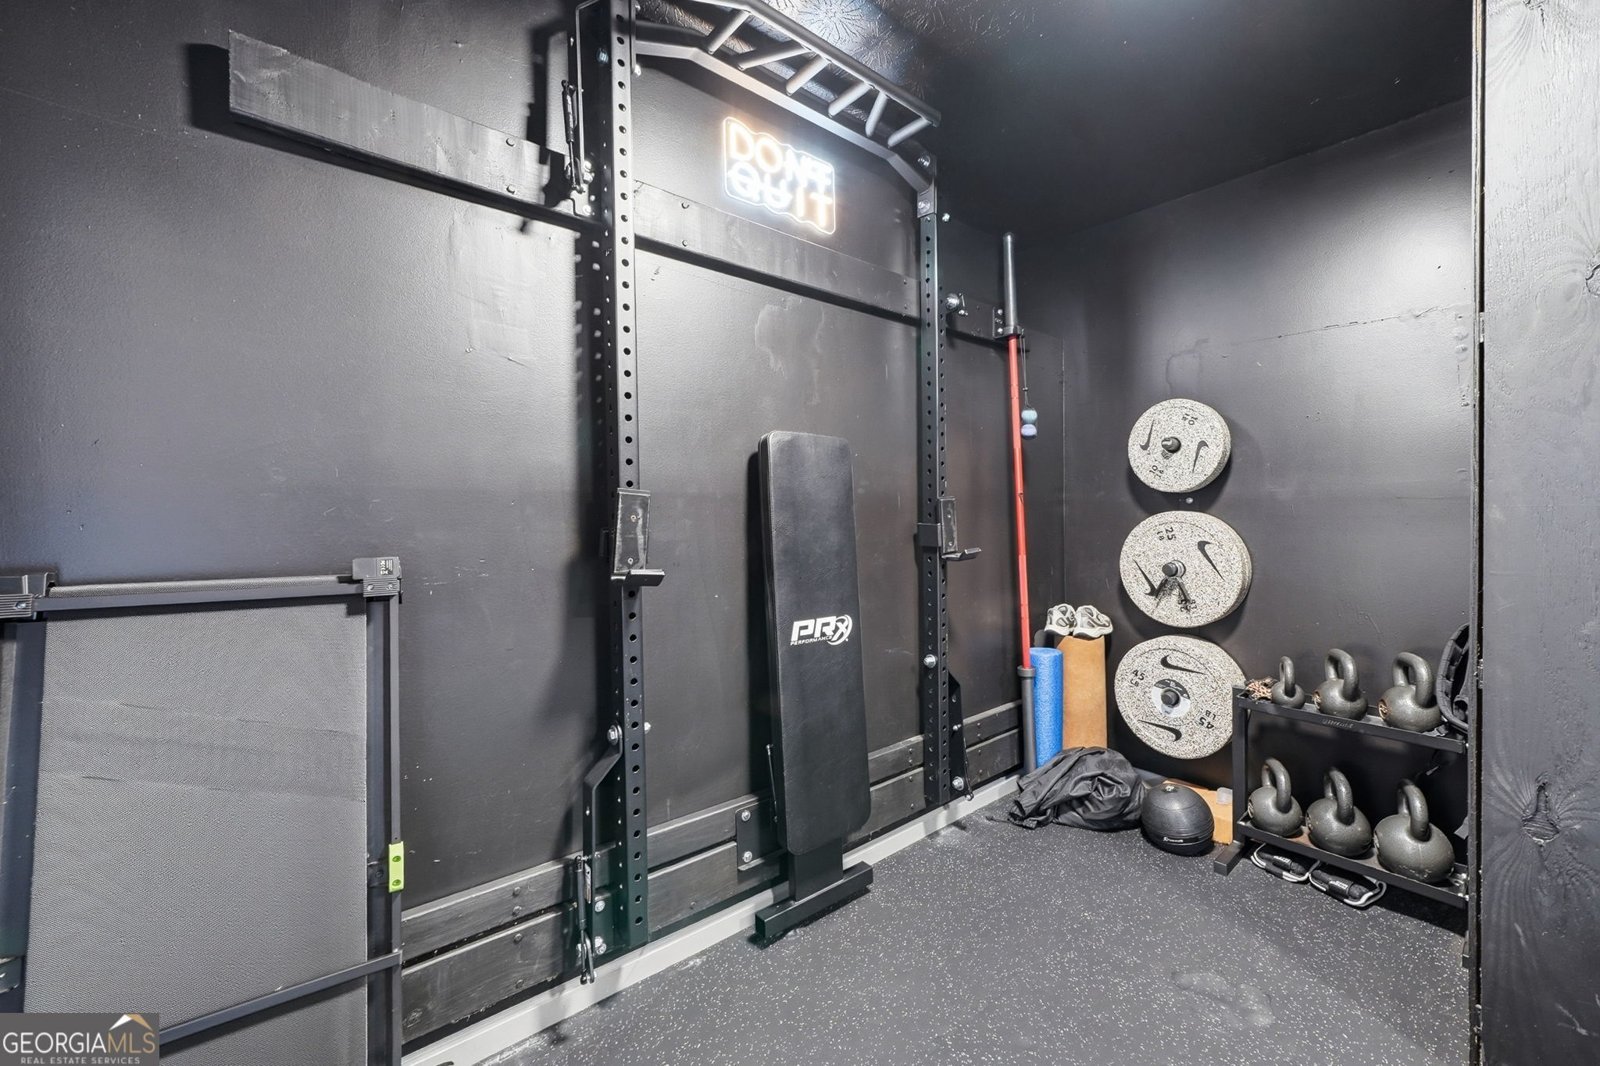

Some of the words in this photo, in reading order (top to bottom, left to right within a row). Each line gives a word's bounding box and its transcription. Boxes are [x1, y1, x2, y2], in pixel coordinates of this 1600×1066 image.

[729, 161, 832, 228] QUIT
[1165, 527, 1176, 541] 25
[1132, 669, 1145, 681] 45
[1199, 717, 1214, 729] 45
